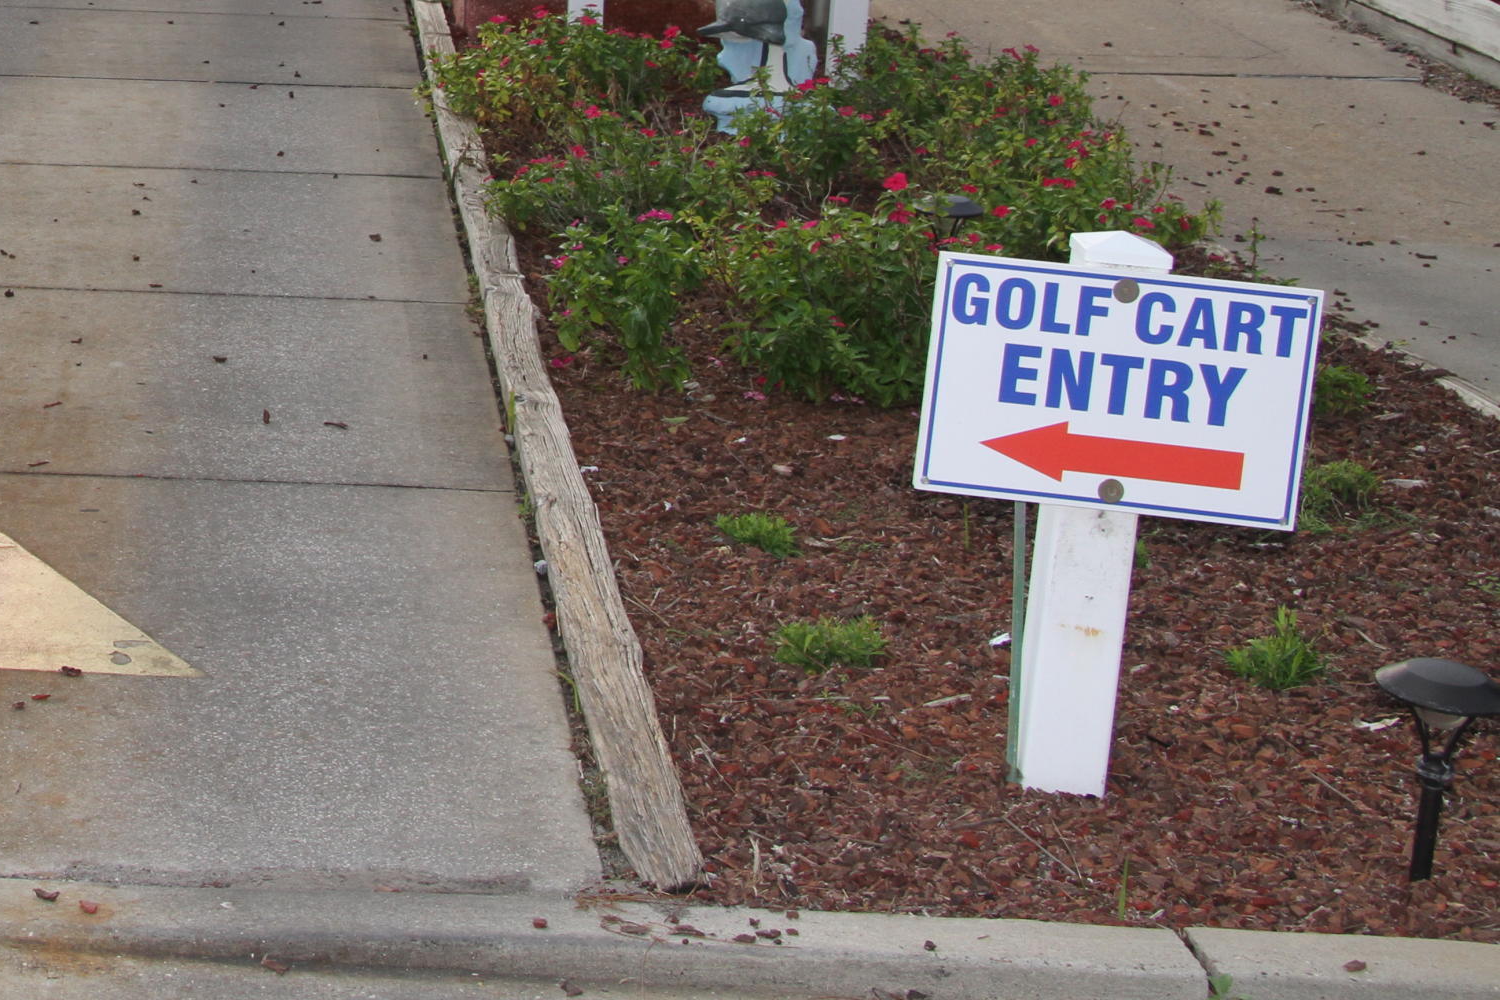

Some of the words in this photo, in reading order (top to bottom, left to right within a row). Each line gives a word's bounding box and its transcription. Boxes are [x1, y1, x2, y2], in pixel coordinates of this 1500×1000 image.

[951, 273, 1113, 336] GOLF
[1135, 292, 1308, 358] CART
[998, 343, 1248, 427] ENTRY
